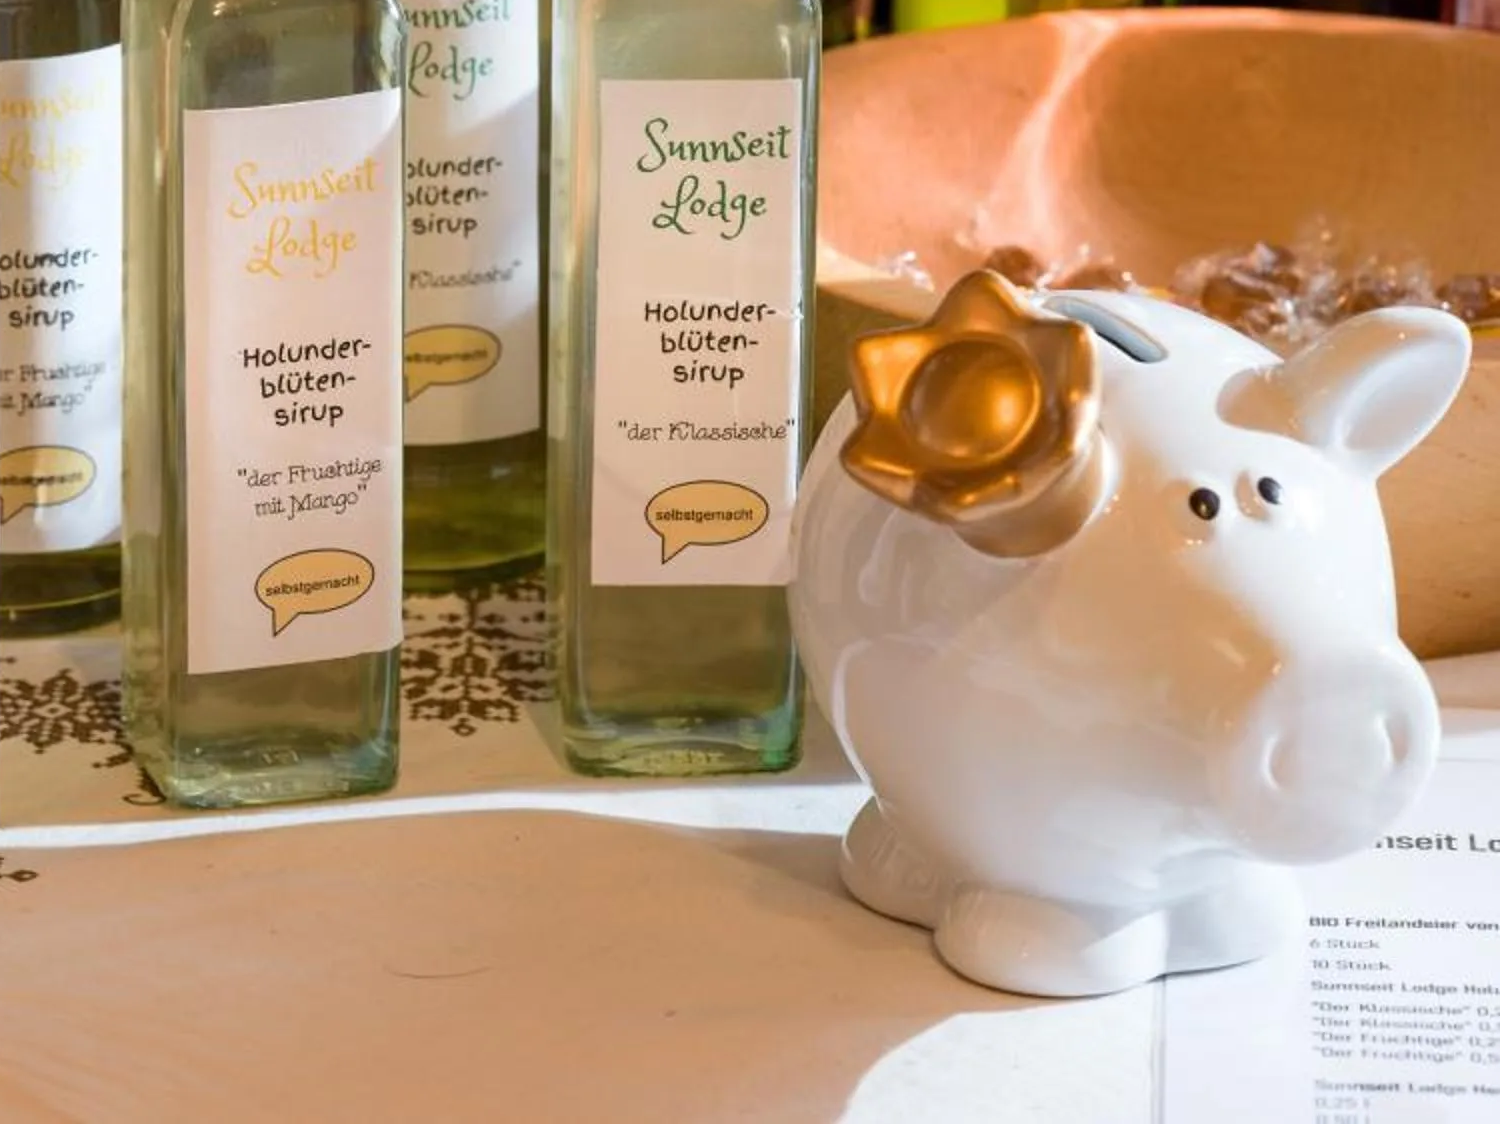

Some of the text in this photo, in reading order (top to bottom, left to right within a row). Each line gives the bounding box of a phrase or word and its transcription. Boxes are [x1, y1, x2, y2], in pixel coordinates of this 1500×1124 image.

[407, 41, 493, 101] Lodge
[407, 157, 503, 179] olunder-
[652, 175, 768, 240] Lodge
[412, 214, 478, 238] sirup
[246, 215, 358, 278] Lodge
[9, 306, 74, 331] sirup
[644, 300, 776, 325] Holunder-
[243, 335, 371, 368] Holunder-
[660, 329, 758, 354] blüten-
[260, 371, 356, 399] blüten-
[673, 359, 745, 389] sirup
[274, 401, 344, 427] sirup
[255, 497, 285, 517] mit
[655, 507, 754, 524] selbstgemacht
[265, 574, 359, 597] selbstgemacht
[1375, 833, 1457, 851] nseit
[1309, 917, 1339, 927] BIO
[1345, 917, 1457, 929] Freilandeier
[1477, 1007, 1500, 1018] 0,2
[1468, 1036, 1500, 1048] 0,2
[1470, 1052, 1500, 1064] 0,5
